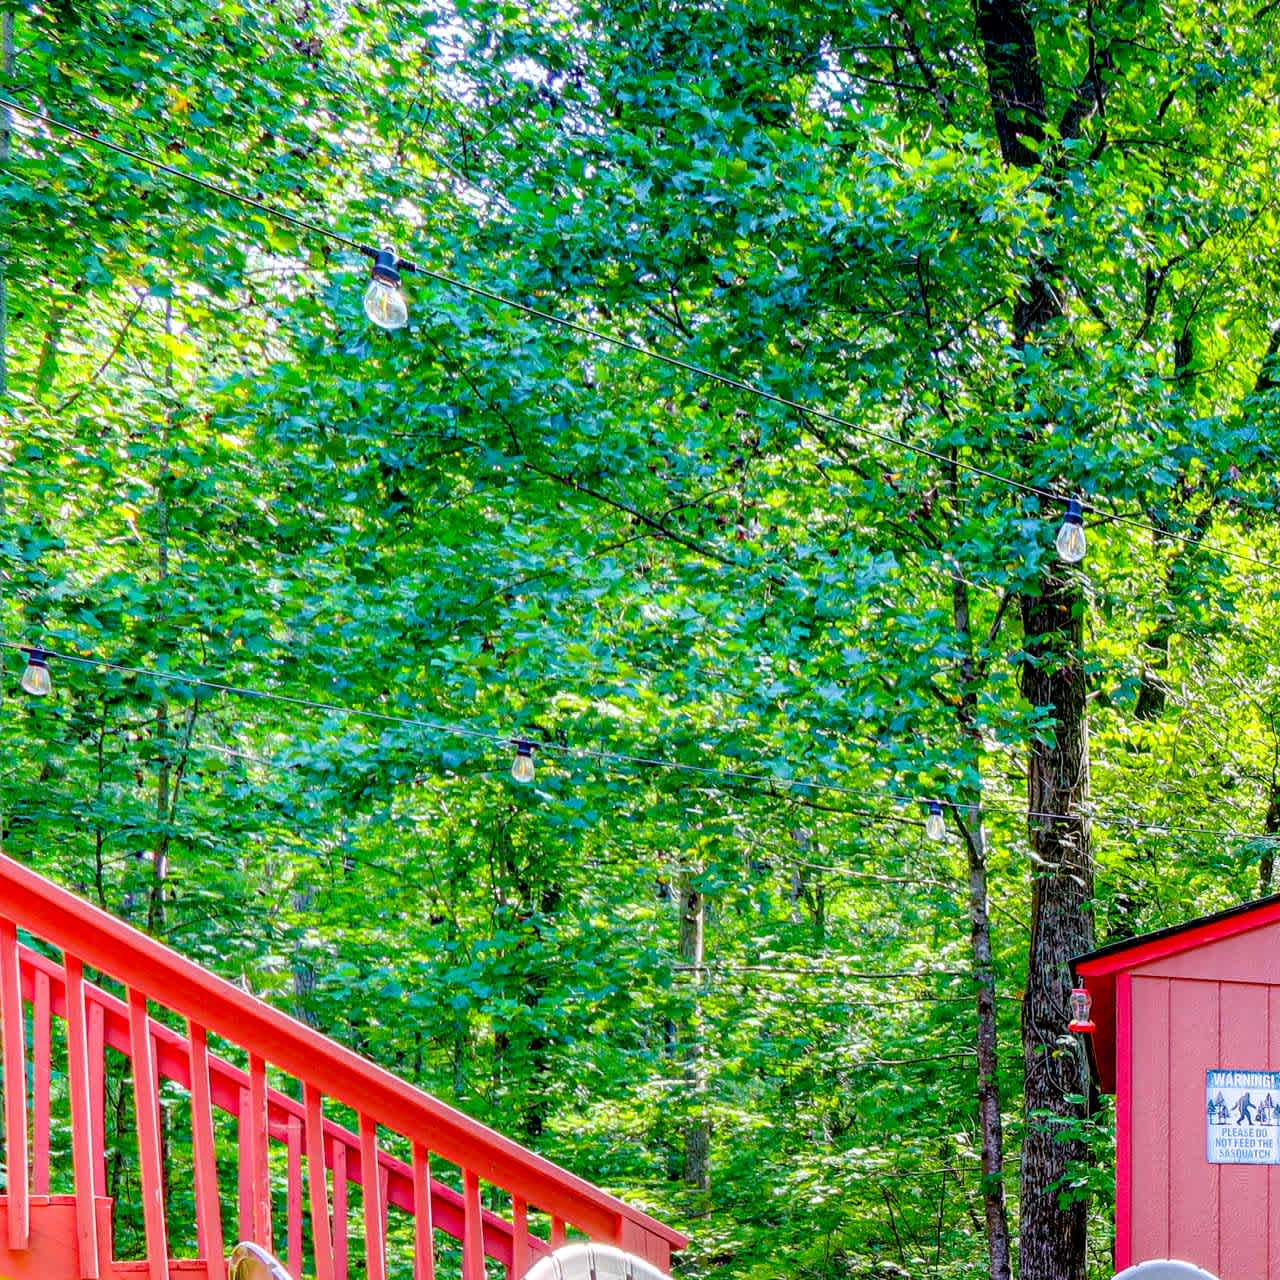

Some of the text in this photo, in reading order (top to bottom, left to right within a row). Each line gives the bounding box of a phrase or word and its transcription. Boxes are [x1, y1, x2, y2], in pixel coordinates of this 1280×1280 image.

[1213, 1072, 1275, 1088] WARNING!
[1221, 1127, 1268, 1138] PLEASE DO
[1215, 1137, 1273, 1148] NOT FEED THE
[1219, 1149, 1271, 1159] SASQUATCH
